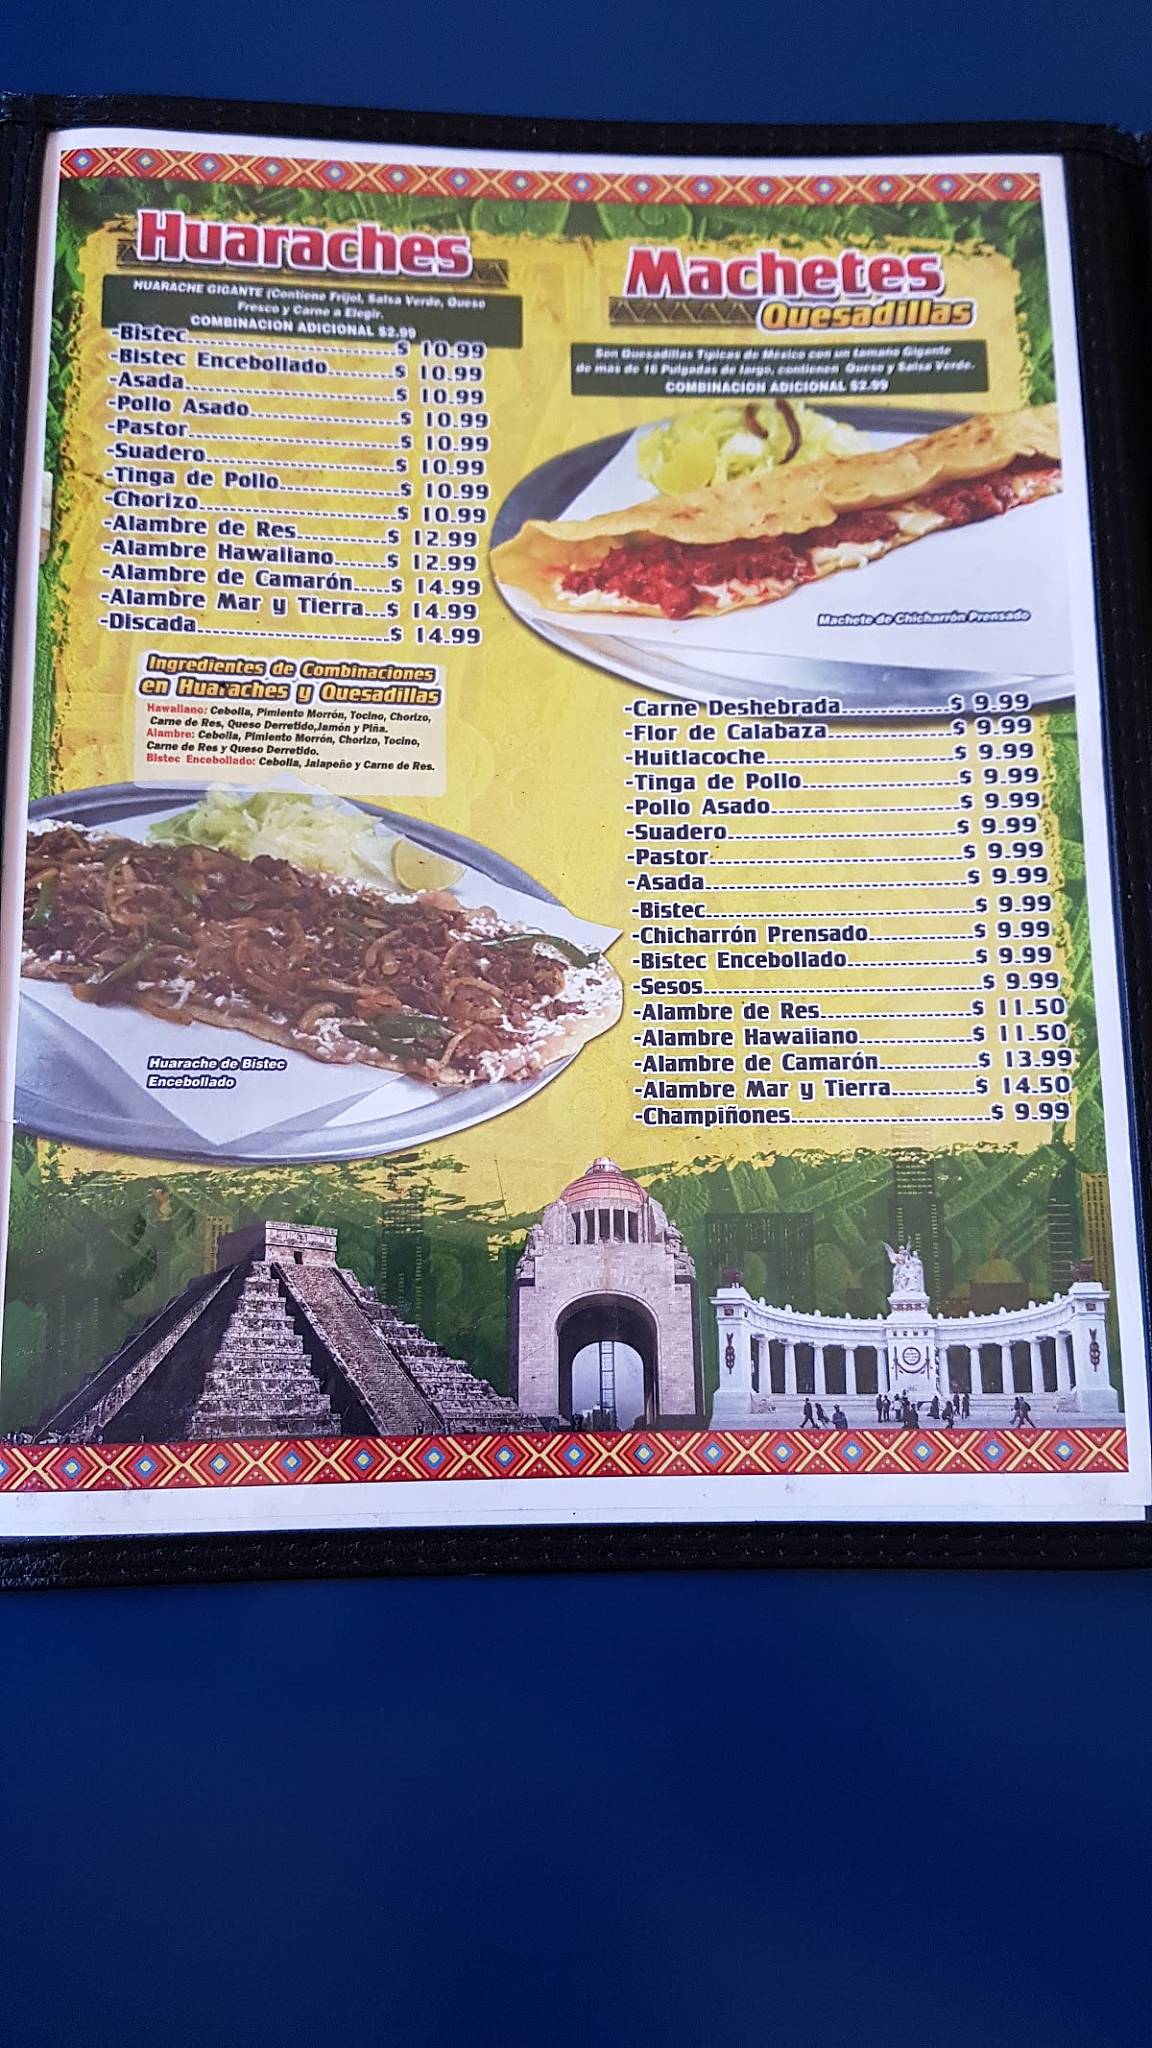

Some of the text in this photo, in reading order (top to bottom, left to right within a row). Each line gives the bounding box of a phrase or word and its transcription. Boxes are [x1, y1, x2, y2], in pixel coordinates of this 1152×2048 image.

[136, 209, 472, 276] Huaraches
[625, 248, 946, 298] Machetes
[133, 279, 205, 294] HUARACHE
[207, 284, 264, 298] GIGANTE
[367, 293, 403, 306] Salsa
[447, 297, 486, 309] Queso
[237, 301, 385, 321] Fresco y Carne a Elegir.
[760, 299, 973, 329] Quesadillas
[190, 315, 417, 340] COMBINACION ADICIONAL $2.99
[424, 342, 484, 358] 10.99
[198, 351, 327, 374] Encebollado
[421, 365, 482, 381] 10.99
[423, 388, 483, 404] 10.99
[664, 378, 890, 394] COMBINACION ADICIONAL $2.99
[183, 398, 249, 416] Asado
[427, 412, 488, 428] 10.99
[427, 436, 488, 451] 10.99
[422, 459, 484, 475] 10.99
[186, 470, 213, 486] de
[225, 471, 279, 489] Pollo
[427, 483, 489, 499] 10.99
[424, 506, 486, 523] 10.99
[218, 519, 245, 536] de
[257, 521, 296, 538] Res
[414, 530, 477, 547] 12.99
[414, 554, 476, 571] 12.99
[217, 568, 244, 585] de
[255, 570, 352, 591] Camarón
[418, 578, 481, 596] 14.99
[217, 592, 261, 611] Mar
[273, 598, 286, 615] y
[297, 597, 363, 616] Tierra
[414, 603, 476, 620] 14.99
[818, 609, 1031, 626] Machete de Chicharrón Prensado
[417, 627, 480, 644] 14.99
[147, 654, 436, 682] Ingredientes de Combinaciones
[140, 679, 170, 694] en
[297, 685, 314, 702] y
[320, 684, 441, 704] Quesadillas
[210, 706, 253, 717] Cebolla,
[257, 708, 304, 718] Pimiento
[307, 709, 347, 720] Morrón,
[350, 711, 386, 722] Tocino,
[390, 712, 431, 723] Chorizo,
[709, 698, 840, 716] Deshebrada
[975, 693, 1029, 711] 9.99
[150, 716, 181, 726] Carne
[184, 718, 198, 726] de
[201, 718, 224, 729] Res,
[228, 720, 261, 729] Queso
[353, 725, 360, 734] y
[362, 724, 388, 733] Piña.
[689, 724, 715, 740] de
[727, 723, 826, 740] Calabaza
[977, 718, 1032, 735] 9.99
[146, 728, 420, 748] Alambre: Cebolla, Pimiento Morrón, Chorizo, Tocino,
[147, 741, 319, 755] Carne de Res y Queso Derretido.
[979, 743, 1033, 760] 9.99
[146, 754, 435, 771] Bistec Encebollado: Cebolla, Jalapeño y Carne de Res.
[707, 773, 734, 790] de
[746, 772, 801, 789] Pollo
[984, 767, 1039, 784] 9.99
[702, 798, 770, 815] Asado
[985, 792, 1040, 809] 9.99
[981, 817, 1037, 834] 9.99
[988, 841, 1043, 859] 9.99
[992, 867, 1048, 884] 9.99
[999, 895, 1051, 913] 9.99
[767, 925, 868, 943] Prensado
[998, 921, 1050, 938] 9.99
[717, 950, 847, 969] Encebollado
[999, 946, 1052, 964] 9.99
[1006, 972, 1059, 990] 9.99
[743, 1002, 770, 1020] de
[780, 1002, 820, 1019] Res
[1000, 996, 1069, 1016] 11.50
[744, 1027, 858, 1046] Hawaiiano
[1001, 1023, 1066, 1042] 11.50
[147, 1056, 288, 1070] Huarache de Bistec
[745, 1054, 771, 1071] de
[782, 1051, 878, 1071] Camarón
[1006, 1049, 1072, 1068] 13.99
[147, 1073, 237, 1089] Encebollado
[746, 1080, 789, 1098] Mar
[800, 1083, 813, 1100] y
[824, 1079, 891, 1097] Tierra
[1004, 1076, 1070, 1094] 14.50
[1015, 1102, 1070, 1120] 9.99
